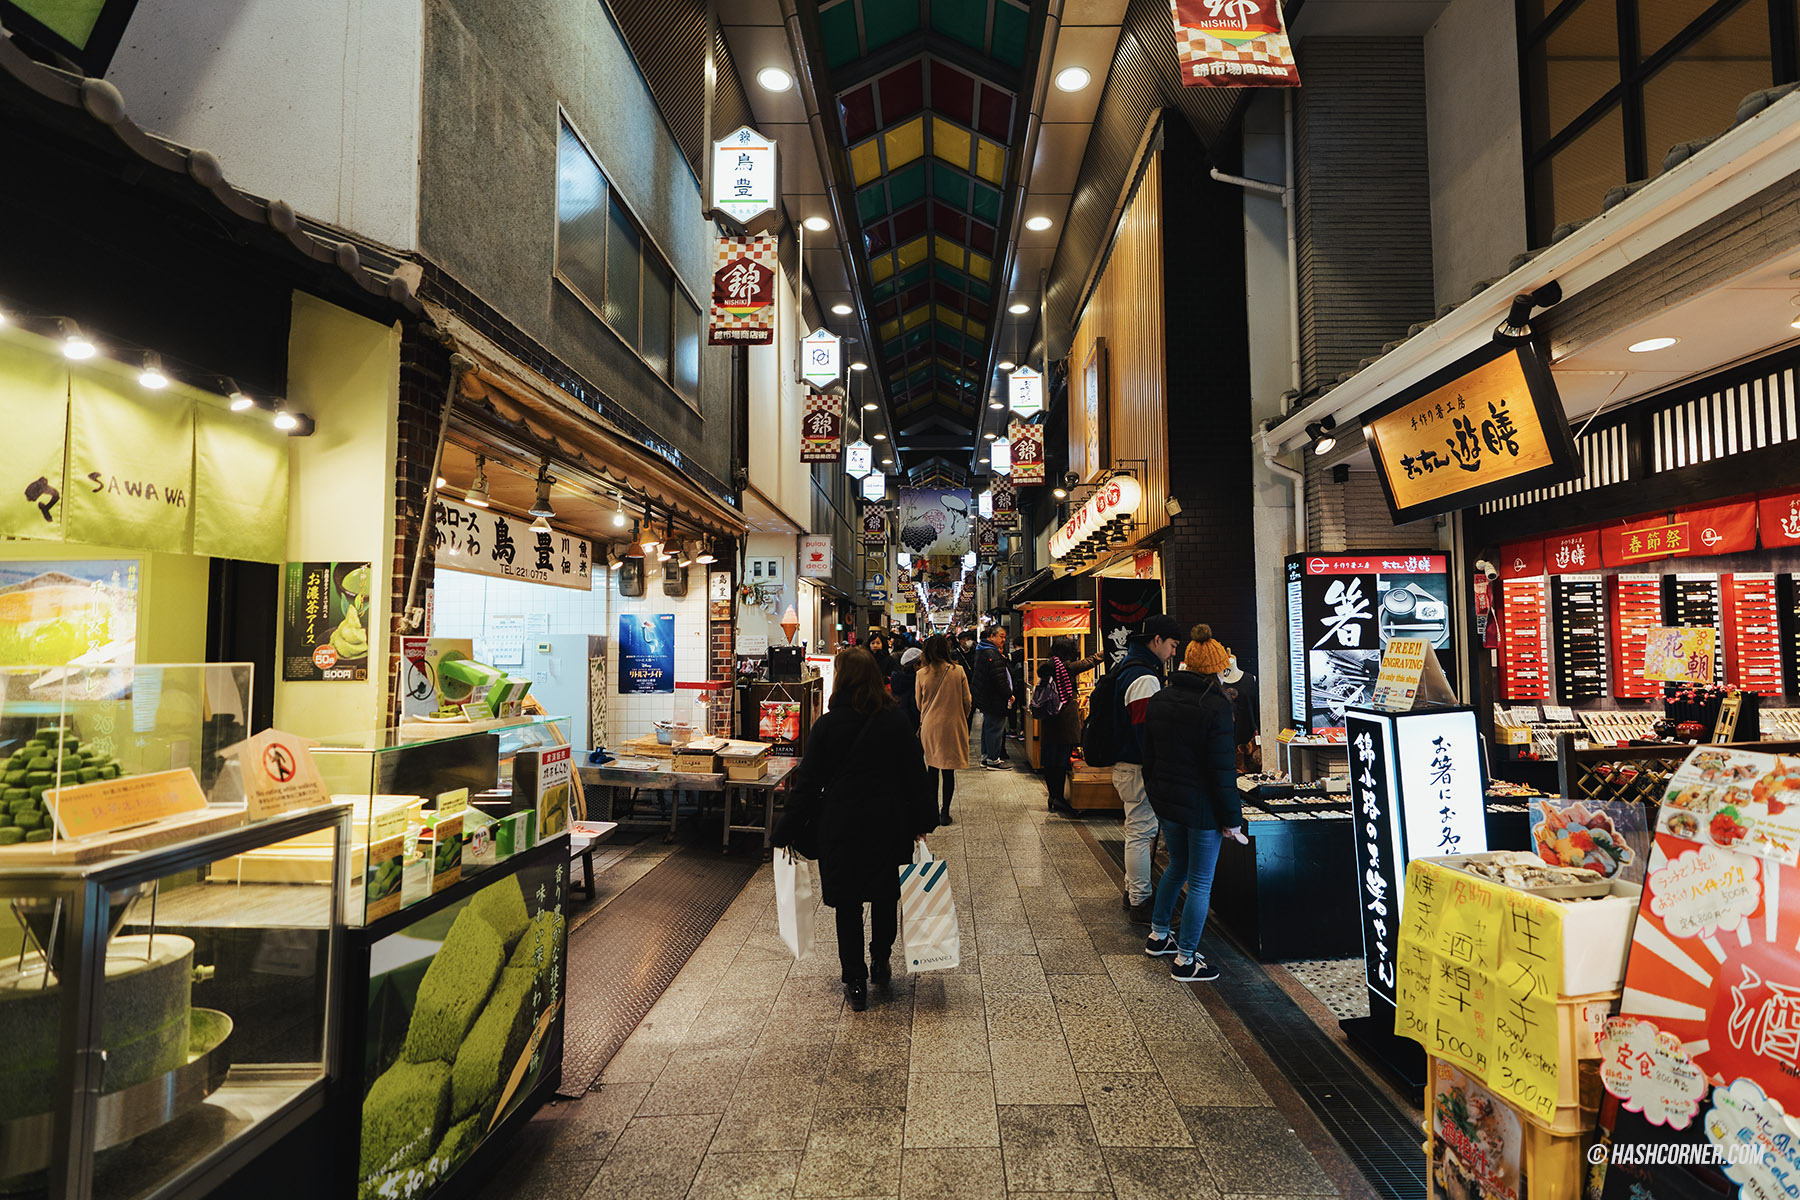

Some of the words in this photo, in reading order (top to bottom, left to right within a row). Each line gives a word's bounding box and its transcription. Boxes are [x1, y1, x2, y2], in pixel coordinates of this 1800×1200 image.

[1201, 19, 1241, 28] NISHIKI
[1192, 61, 1289, 78] 錦市場商店街
[734, 153, 754, 198] 鳥豊
[721, 262, 761, 307] 錦
[713, 328, 769, 341] 錦市場商店街
[807, 412, 833, 440] 錦
[1410, 393, 1466, 432] 手作り箸工房
[1013, 439, 1037, 465] 錦
[435, 527, 482, 557] かしわ
[1555, 543, 1587, 569] 遊膳
[1628, 529, 1683, 554] 春節祭
[499, 563, 515, 576] TEL
[516, 566, 529, 578] 221
[530, 569, 549, 581] 0775
[1333, 562, 1371, 570] 手作り箸工房
[305, 572, 321, 645] お濃茶アイス
[1312, 576, 1374, 650] 箸
[1381, 657, 1423, 670] ENGRAVING
[1389, 642, 1422, 656] FREE!!
[1663, 630, 1709, 681] 花朝
[629, 670, 663, 679] リトルマーメイド
[1386, 673, 1395, 682] only
[1396, 674, 1405, 682] this
[775, 705, 786, 744] あまおう
[1353, 732, 1394, 990] 錦小路のお箸やさん
[1454, 879, 1492, 908] 名物
[550, 864, 564, 1023] 香り豊かな抹茶と
[1400, 961, 1431, 985] Grilled
[1440, 931, 1474, 1013] 酒粕汁
[1436, 1019, 1487, 1070] 500円
[1497, 1017, 1525, 1044] Raw
[1616, 1043, 1656, 1080] 定食
[1500, 1066, 1553, 1115] 300円
[1441, 1114, 1490, 1174] 酒粕汁
